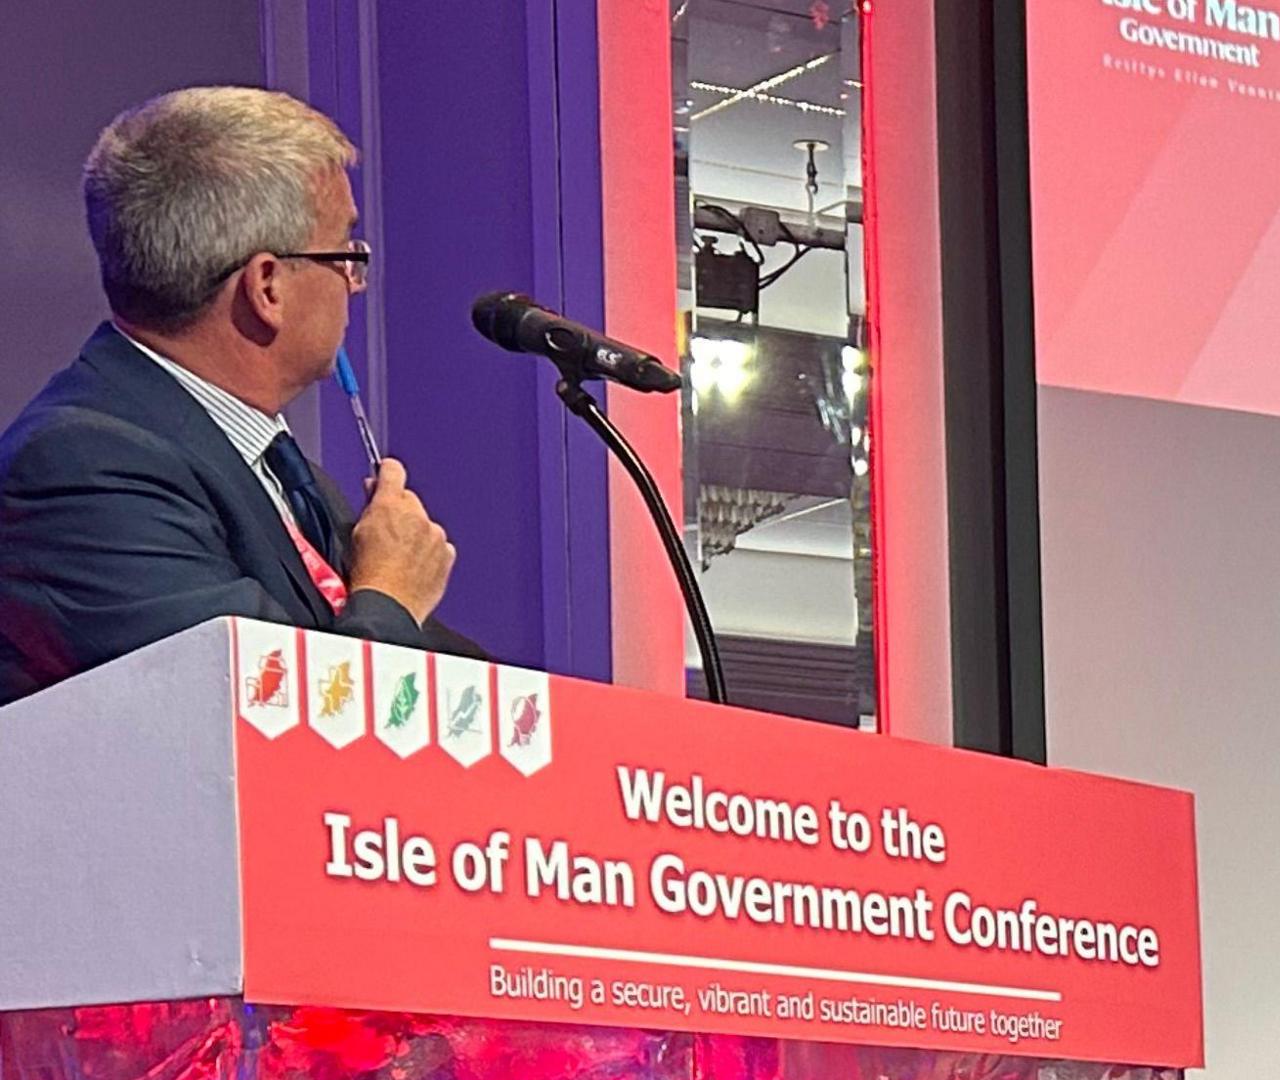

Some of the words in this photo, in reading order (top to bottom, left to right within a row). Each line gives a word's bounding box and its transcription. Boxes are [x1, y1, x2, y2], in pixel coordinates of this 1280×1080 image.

[1118, 17, 1261, 68] Government
[616, 765, 820, 846] Welcome
[828, 800, 871, 853] to
[881, 807, 947, 863] the
[323, 811, 438, 887] Isle
[452, 830, 511, 893] of
[524, 837, 636, 908] Man
[650, 852, 935, 942] Government
[944, 891, 1161, 968] Conference
[488, 964, 585, 1010] Building
[590, 979, 606, 1005] a
[611, 980, 692, 1016] secure,
[697, 983, 772, 1018] vibrant
[776, 990, 814, 1021] and
[819, 996, 928, 1030] sustainable
[930, 1001, 987, 1034] future
[989, 1009, 1063, 1044] together
